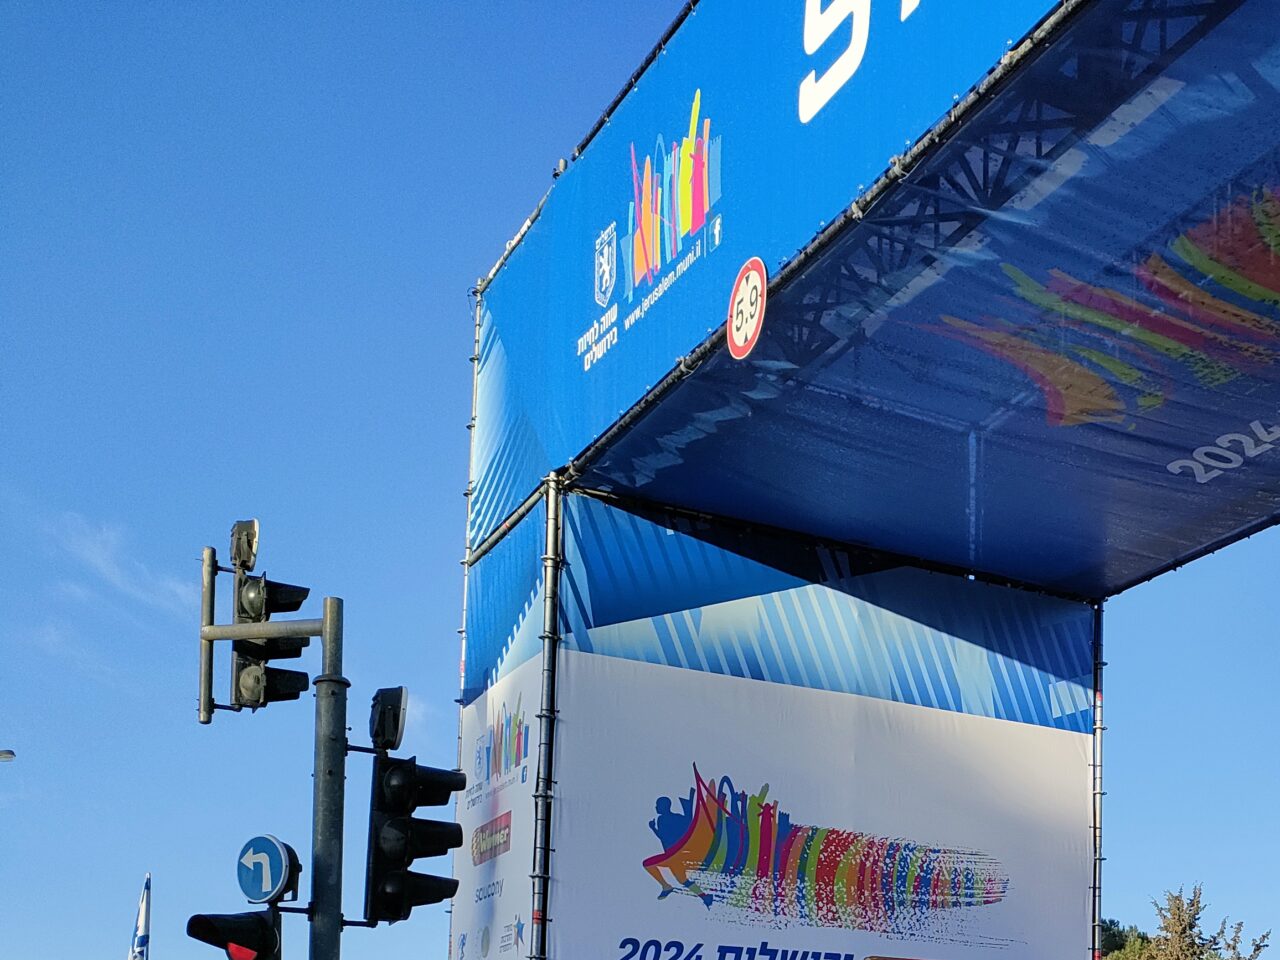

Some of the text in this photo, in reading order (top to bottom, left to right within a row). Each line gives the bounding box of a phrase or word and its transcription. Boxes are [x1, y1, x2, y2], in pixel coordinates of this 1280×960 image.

[624, 239, 701, 330] www.jerusalem.muni.il
[735, 284, 758, 333] 5.9
[475, 878, 504, 903] saucony
